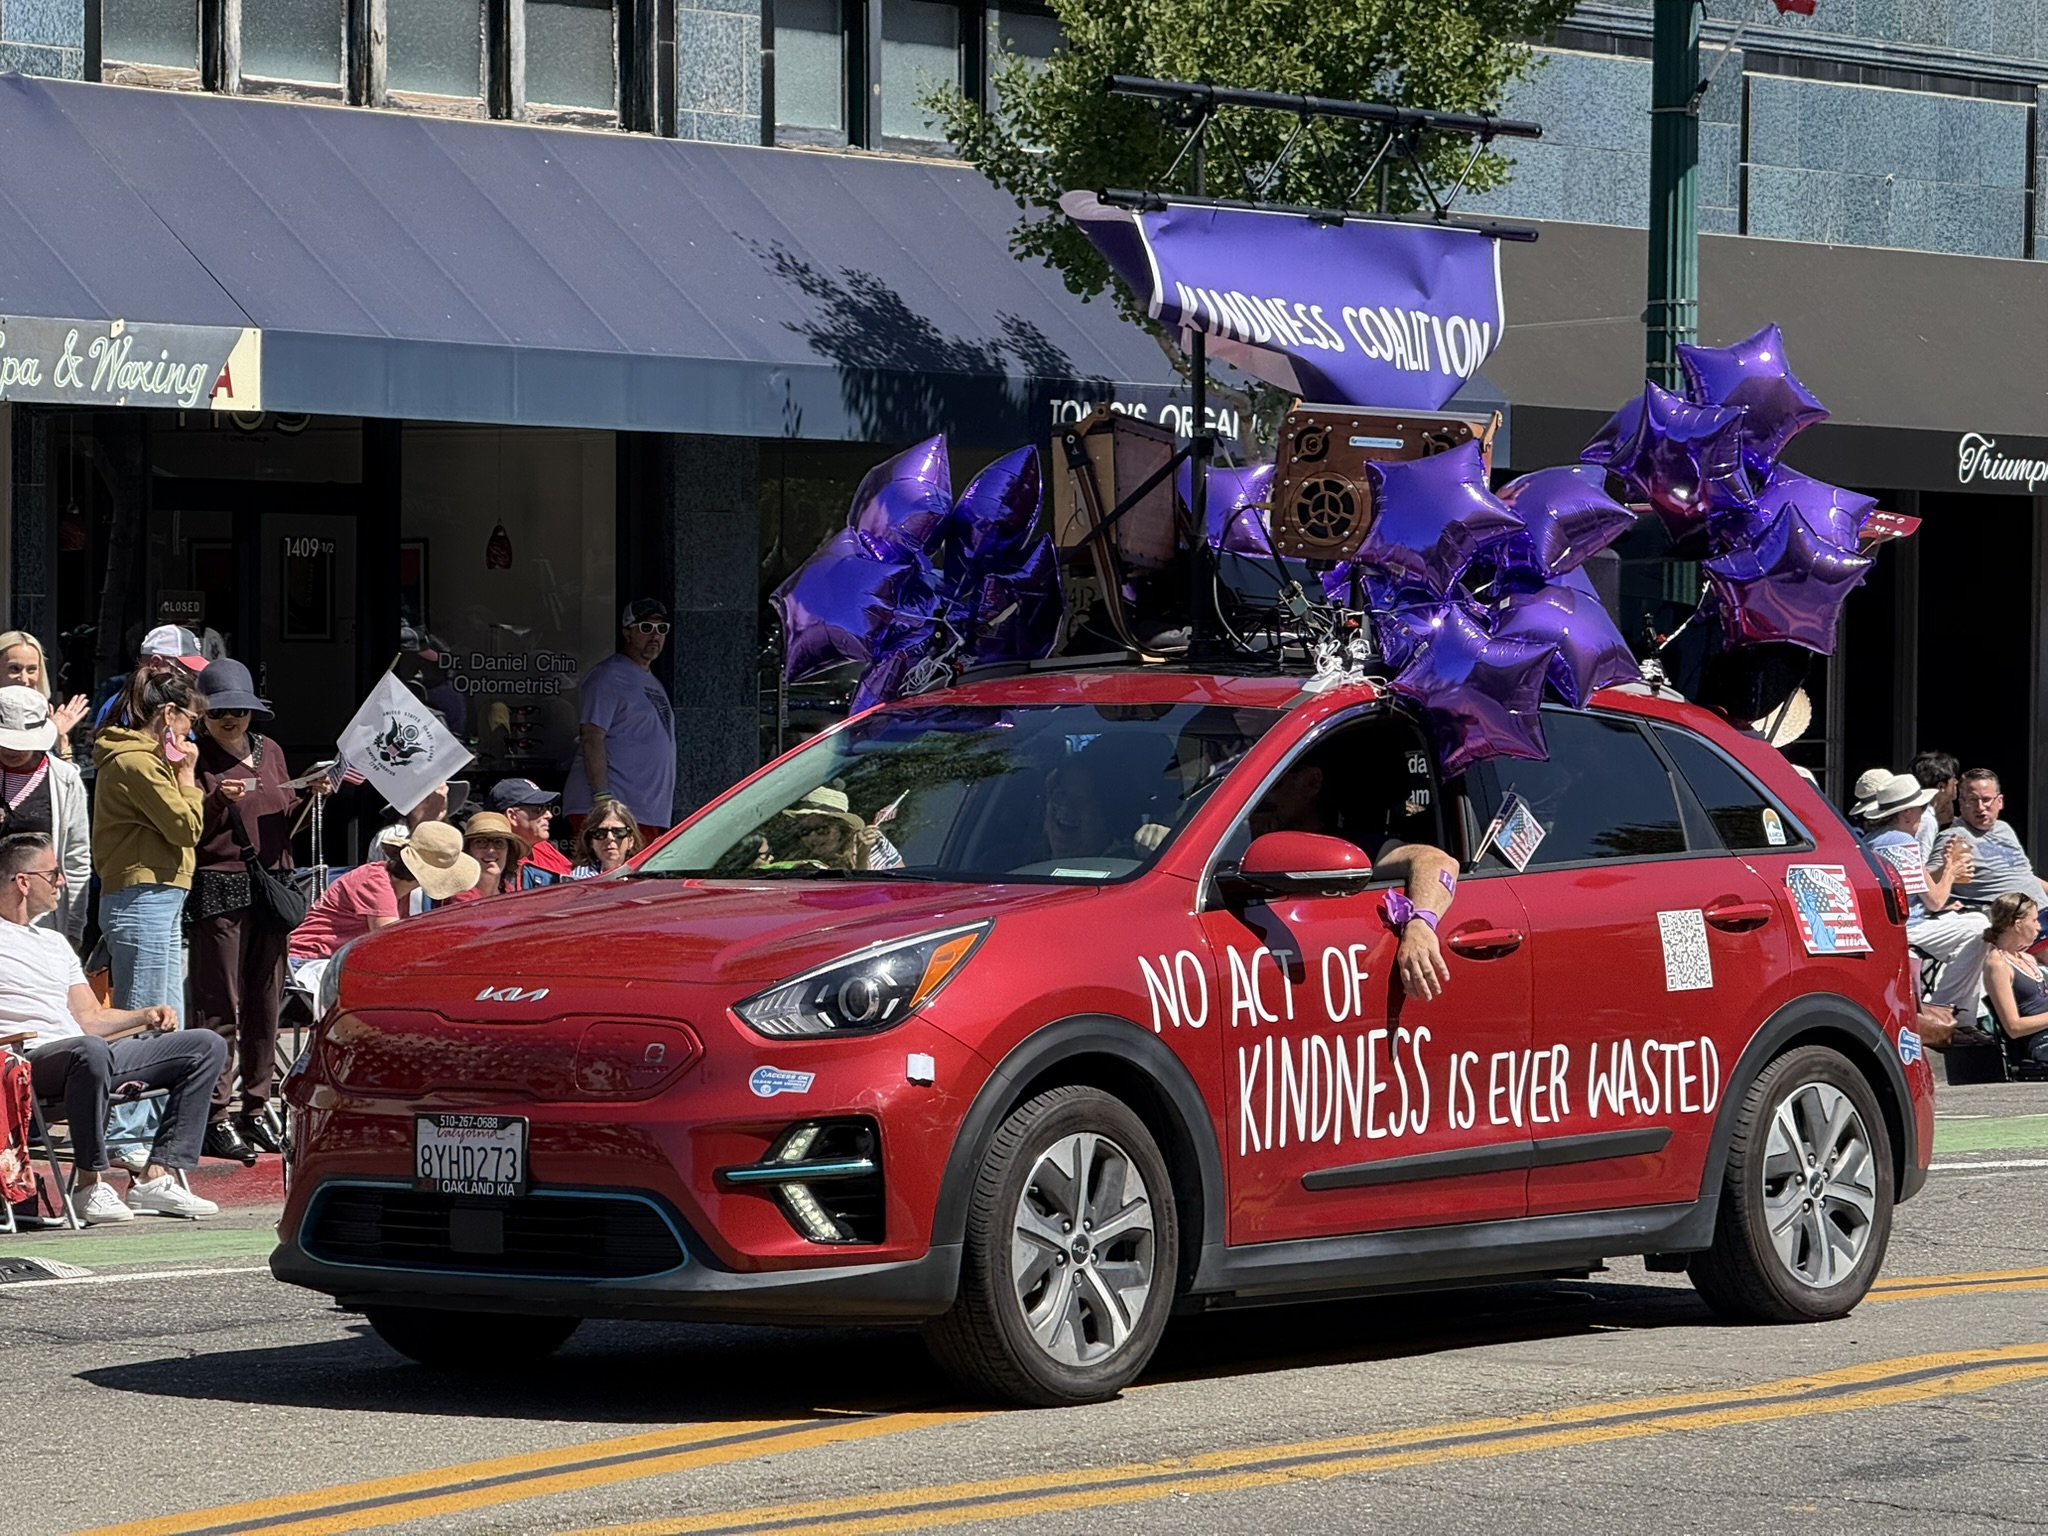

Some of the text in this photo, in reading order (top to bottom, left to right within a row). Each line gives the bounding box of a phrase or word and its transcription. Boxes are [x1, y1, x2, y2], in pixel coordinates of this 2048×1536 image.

[1176, 281, 1490, 380] KINDNESS COALITION
[0, 329, 208, 408] pa & Waxing
[1959, 432, 2048, 492] Triump
[284, 537, 335, 557] 1409 1/2
[162, 601, 200, 613] CLOSED
[438, 652, 577, 672] Dr. Daniel Chin
[453, 675, 560, 697] Optometrist
[1809, 868, 1820, 881] NO
[1138, 943, 1369, 1033] NO ACT OF
[1239, 1026, 1720, 1156] KINDNESS IS EVER WASTED
[437, 1126, 505, 1144] California
[421, 1144, 517, 1182] 8YHD273
[442, 1181, 515, 1196] OAKLAND KIA
